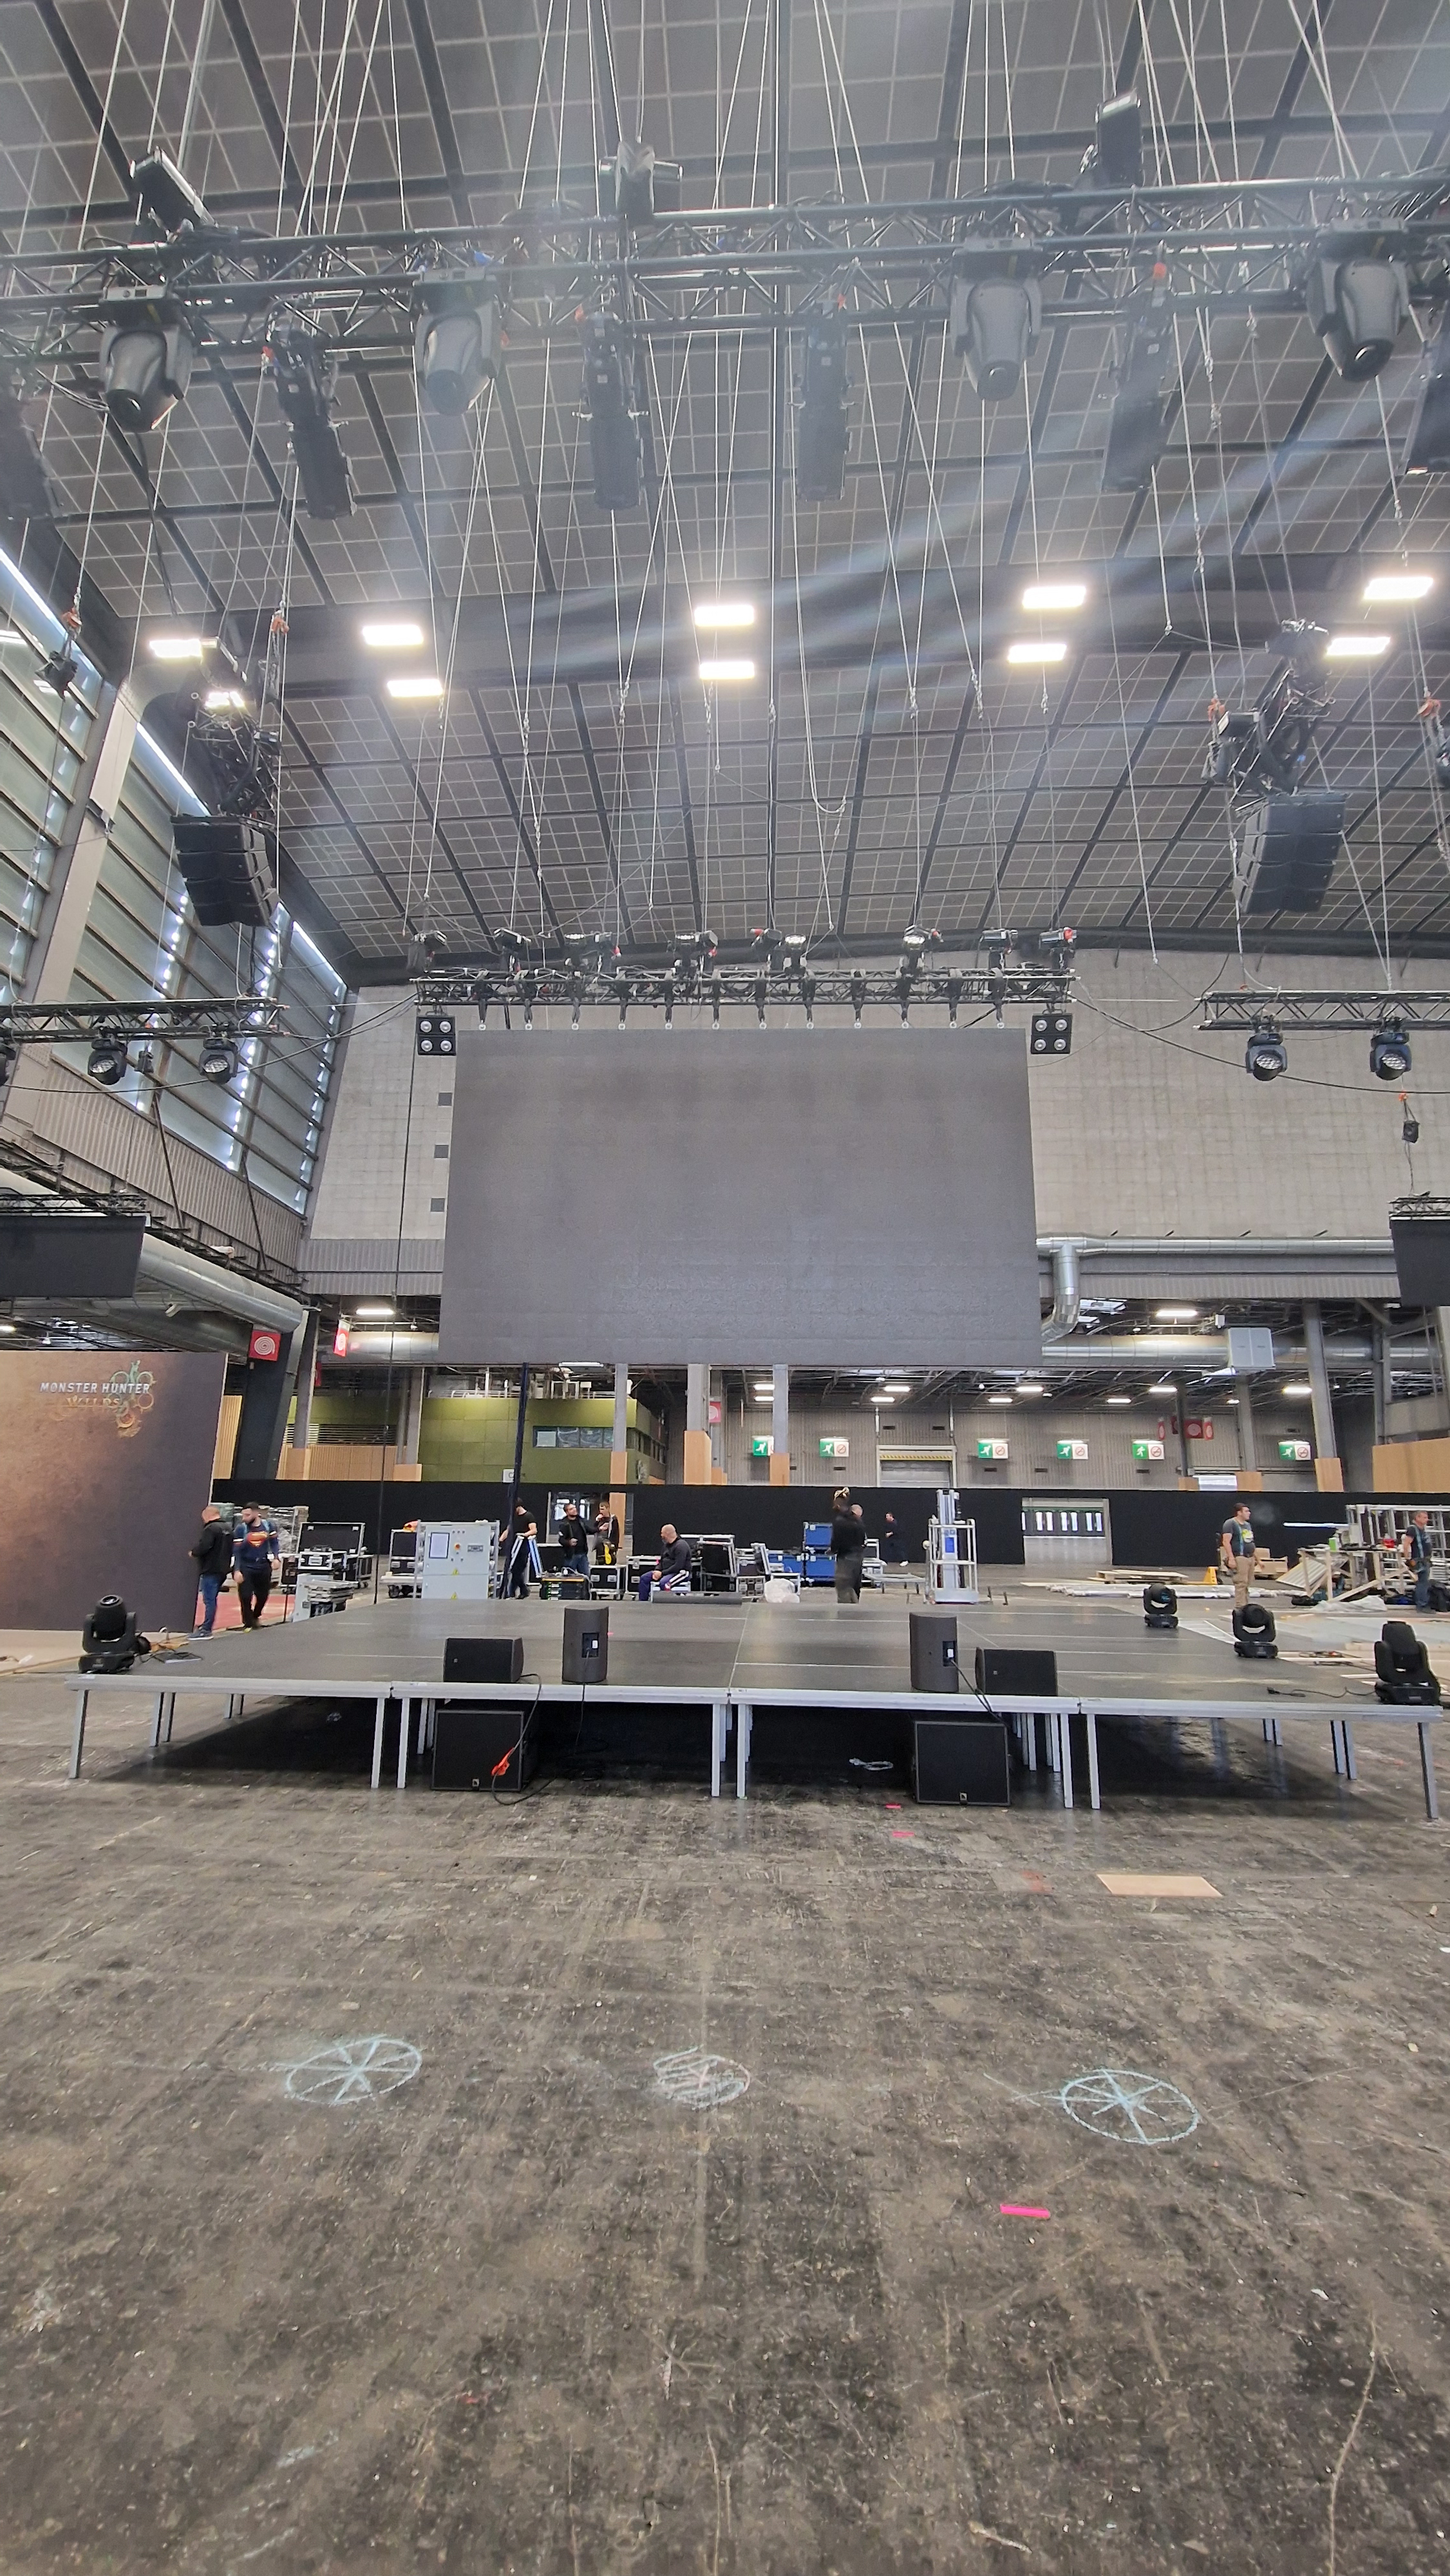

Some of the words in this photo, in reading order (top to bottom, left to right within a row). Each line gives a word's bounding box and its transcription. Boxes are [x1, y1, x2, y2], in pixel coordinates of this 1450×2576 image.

[40, 1383, 97, 1393] MONSTER
[102, 1383, 150, 1394] HUNTER
[65, 1395, 120, 1407] WILDS
